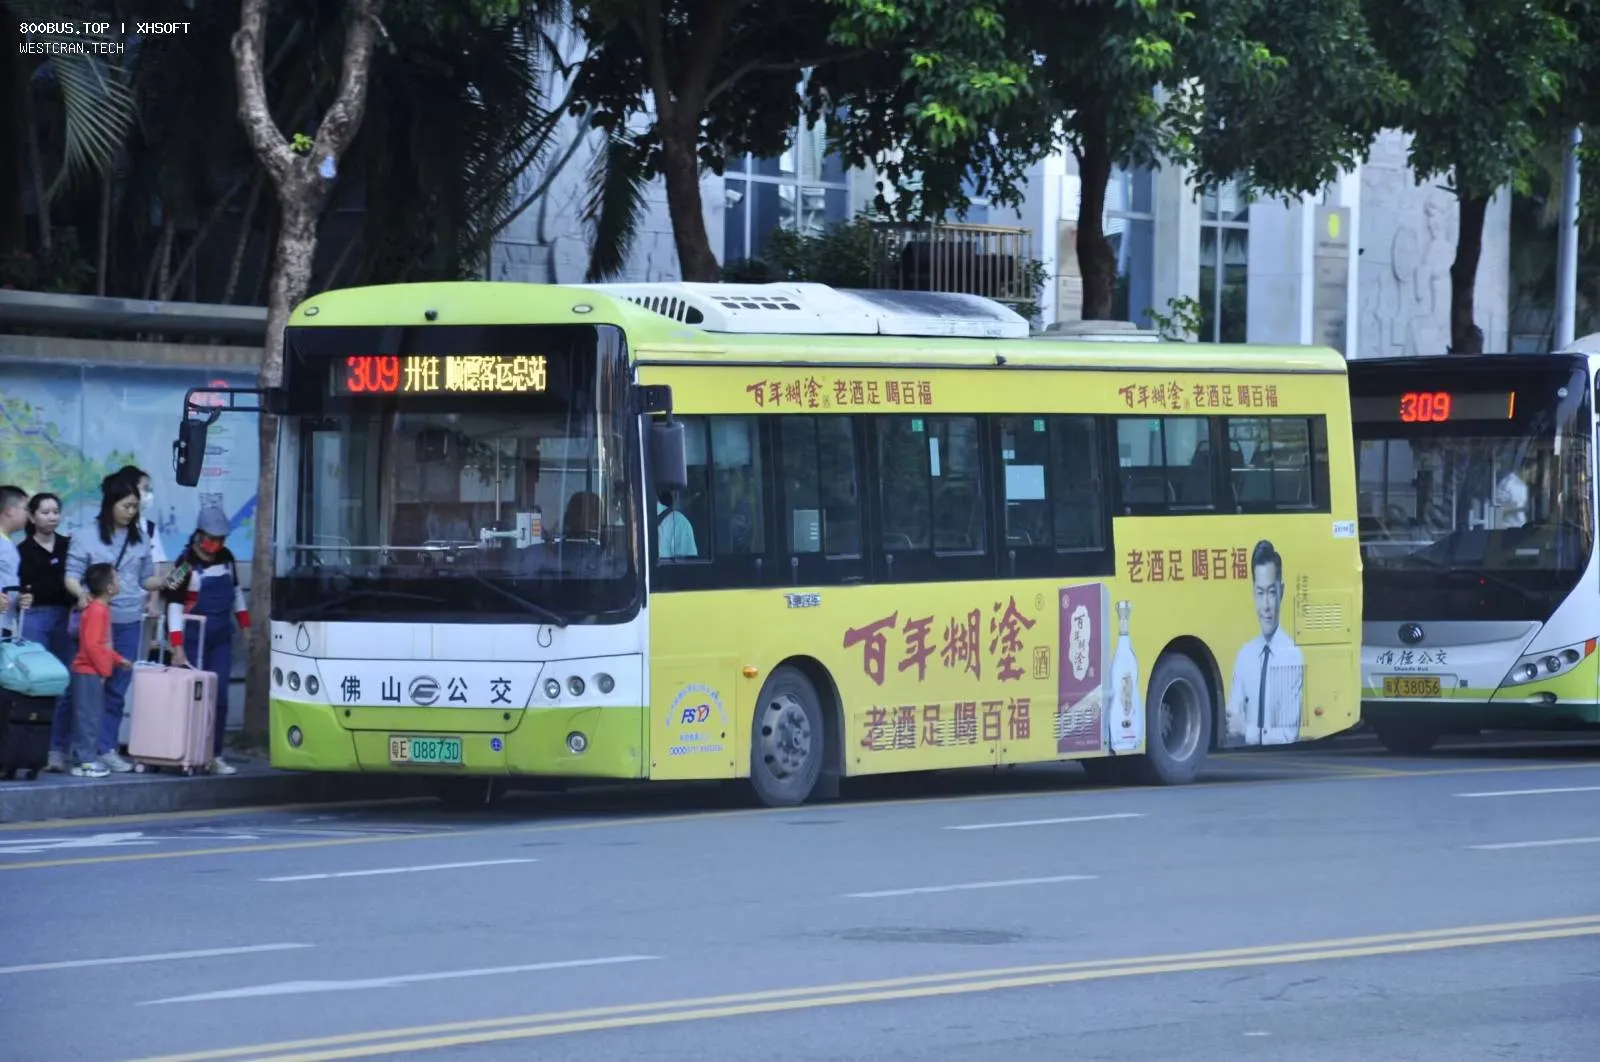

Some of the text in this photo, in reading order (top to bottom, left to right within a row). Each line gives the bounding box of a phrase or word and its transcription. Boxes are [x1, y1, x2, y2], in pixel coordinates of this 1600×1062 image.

[346, 355, 399, 392] 309
[833, 379, 881, 406] 老酒足
[885, 380, 933, 406] 喝百福
[1192, 385, 1234, 408] 老酒足
[1237, 385, 1279, 408] 喝百福
[1401, 392, 1452, 422] 309
[1126, 547, 1249, 583] 老酒足 喝百福
[340, 675, 512, 704] 佛山 公交
[1403, 679, 1440, 695] 38056
[861, 697, 1032, 750] 老酒足 喝百福
